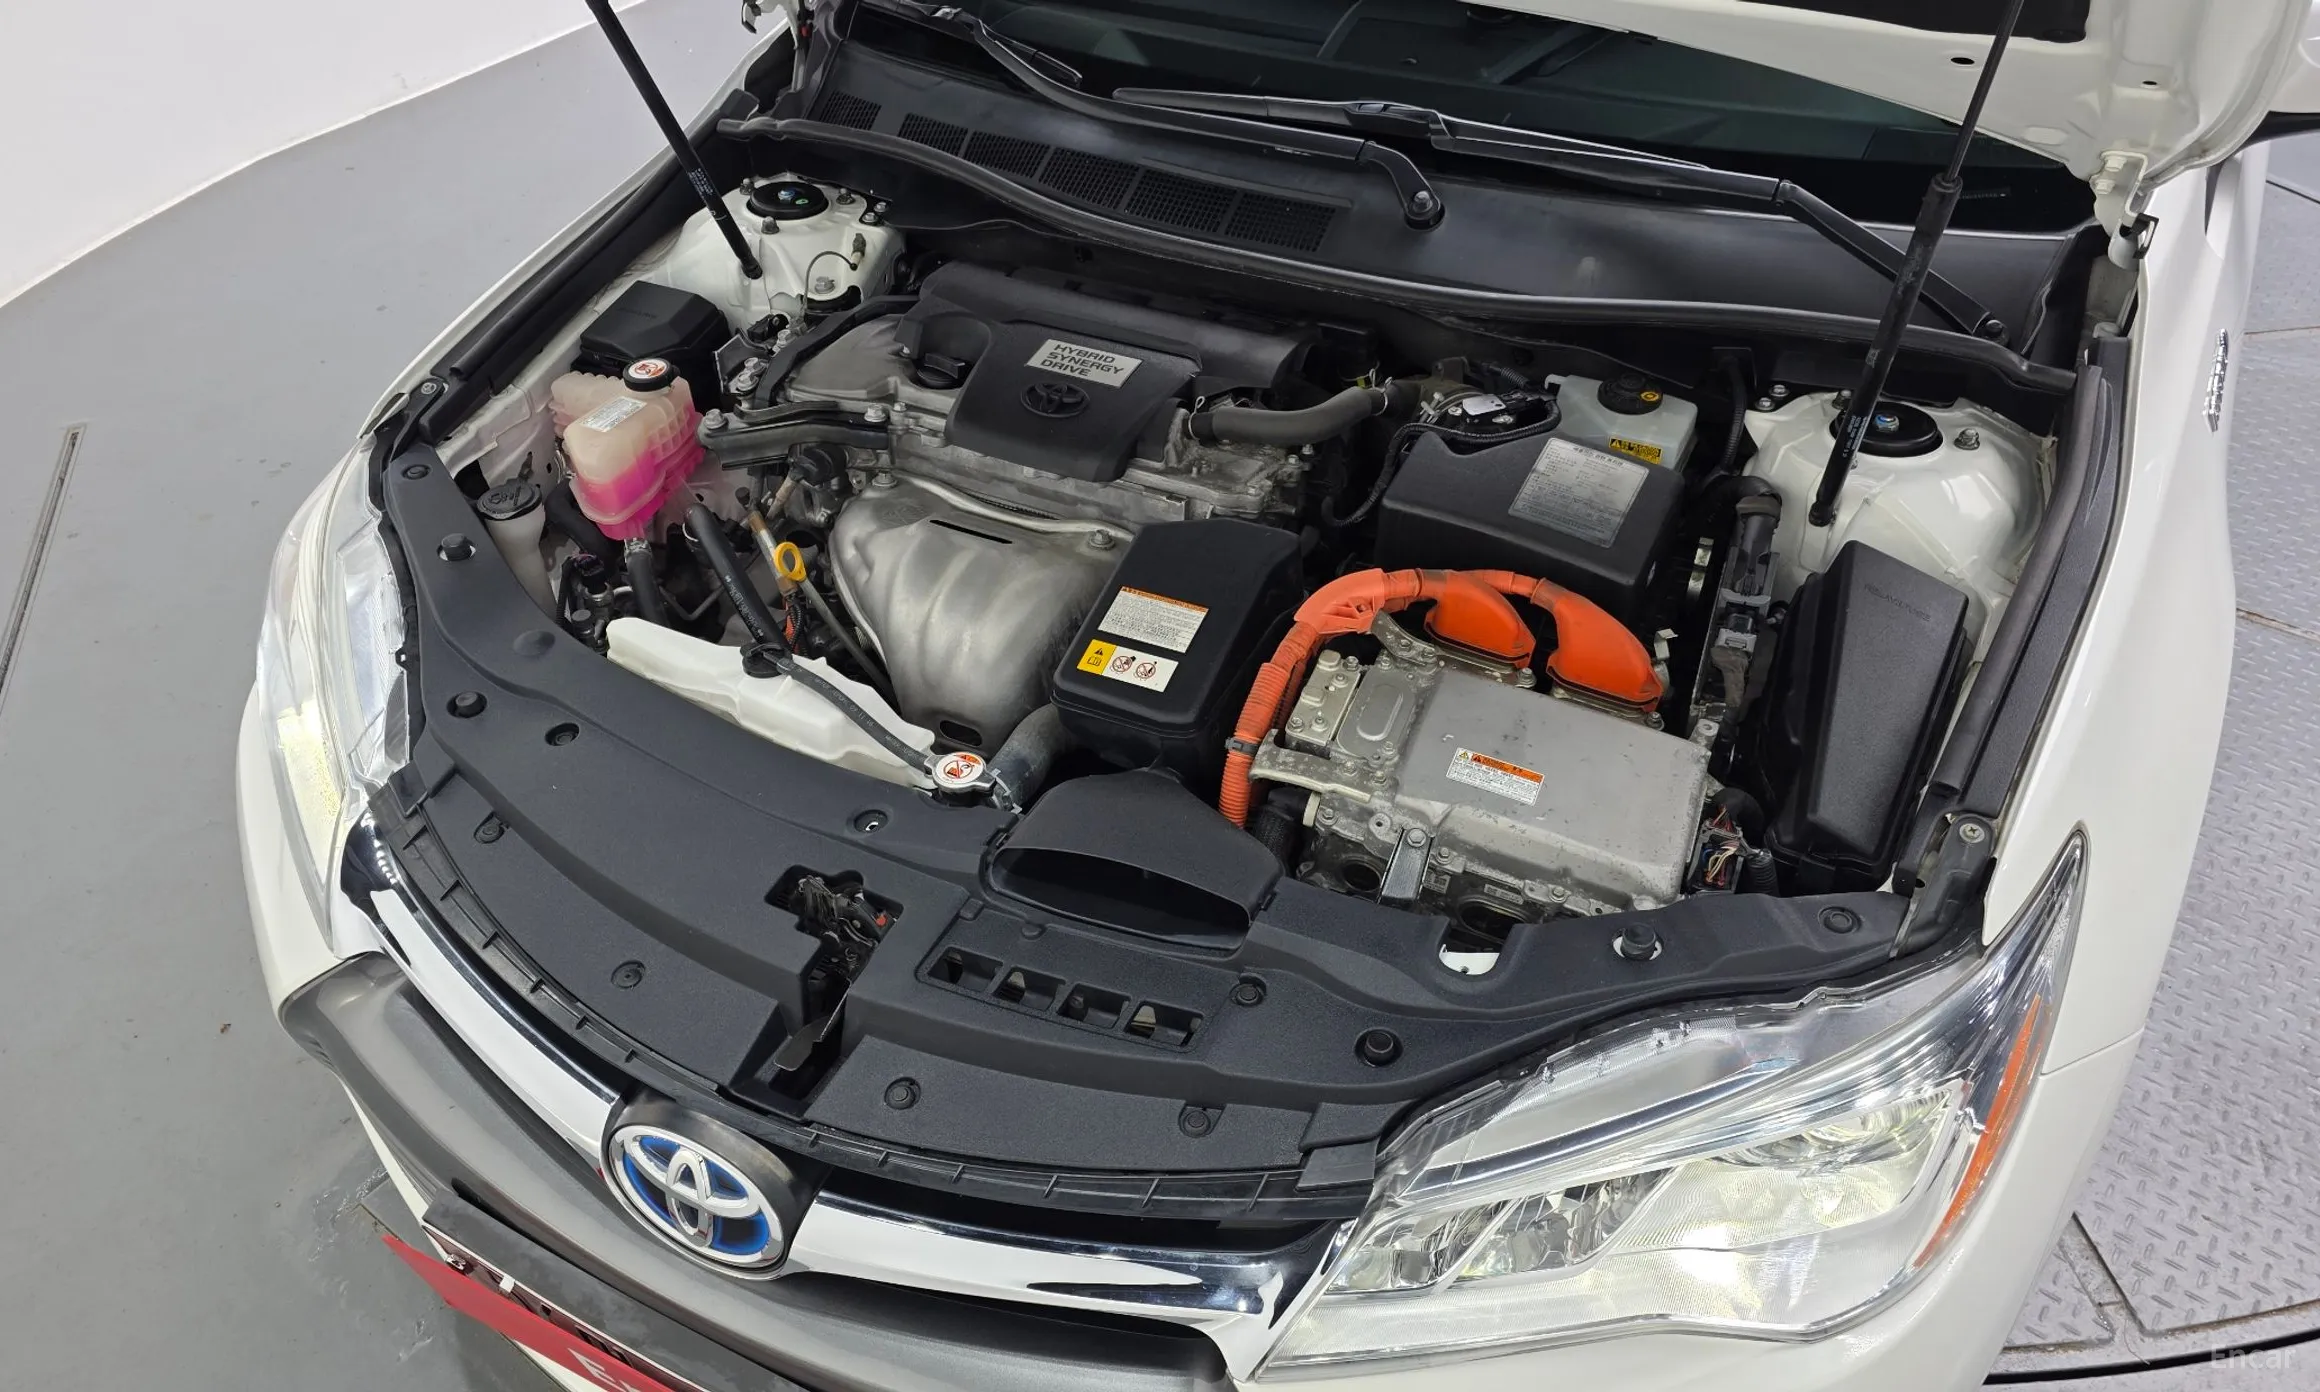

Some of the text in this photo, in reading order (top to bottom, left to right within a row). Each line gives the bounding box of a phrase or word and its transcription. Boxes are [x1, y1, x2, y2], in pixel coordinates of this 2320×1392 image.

[1046, 351, 1125, 375] SYNERGY
[1054, 344, 1116, 364] HYBRID
[1040, 358, 1092, 376] DRIVE
